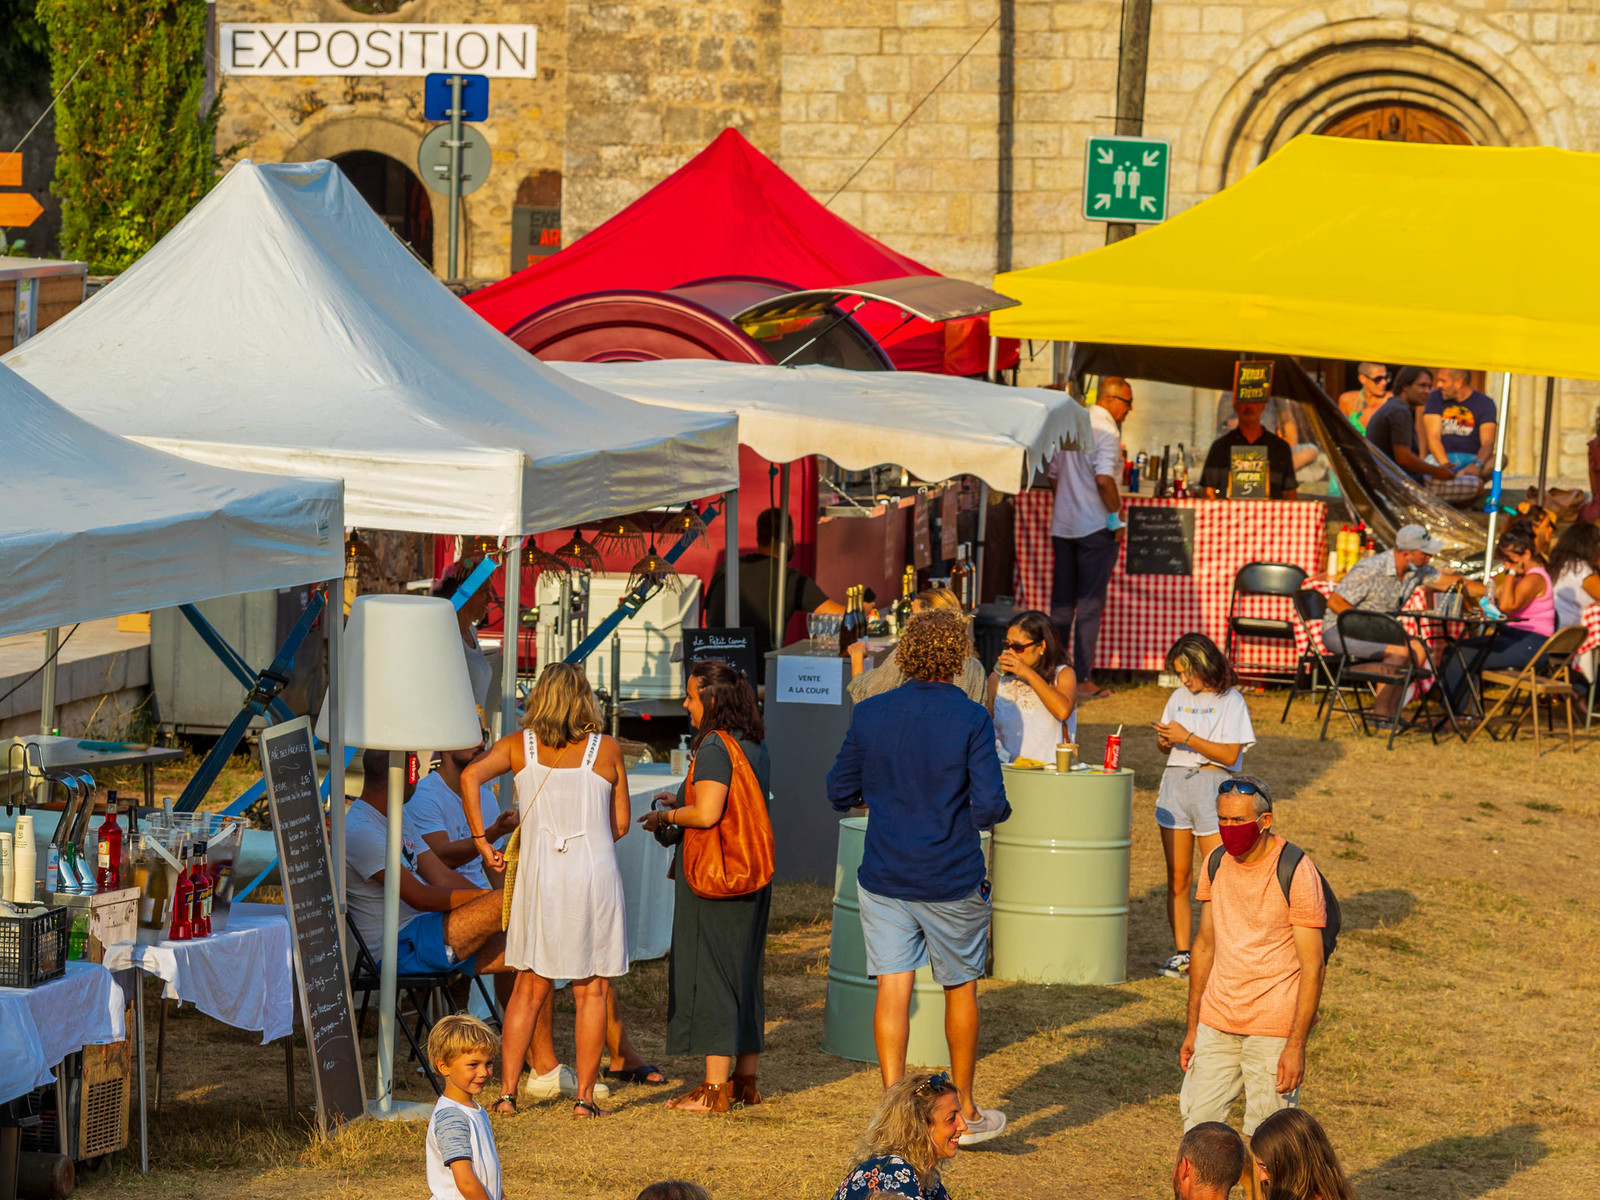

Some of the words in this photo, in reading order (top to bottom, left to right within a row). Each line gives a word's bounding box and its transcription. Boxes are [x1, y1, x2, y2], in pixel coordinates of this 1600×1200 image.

[231, 29, 528, 70] EXPOSITION
[798, 674, 821, 683] VENTE
[788, 686, 795, 694] A
[795, 686, 804, 694] LA
[805, 686, 830, 695] COUPE
